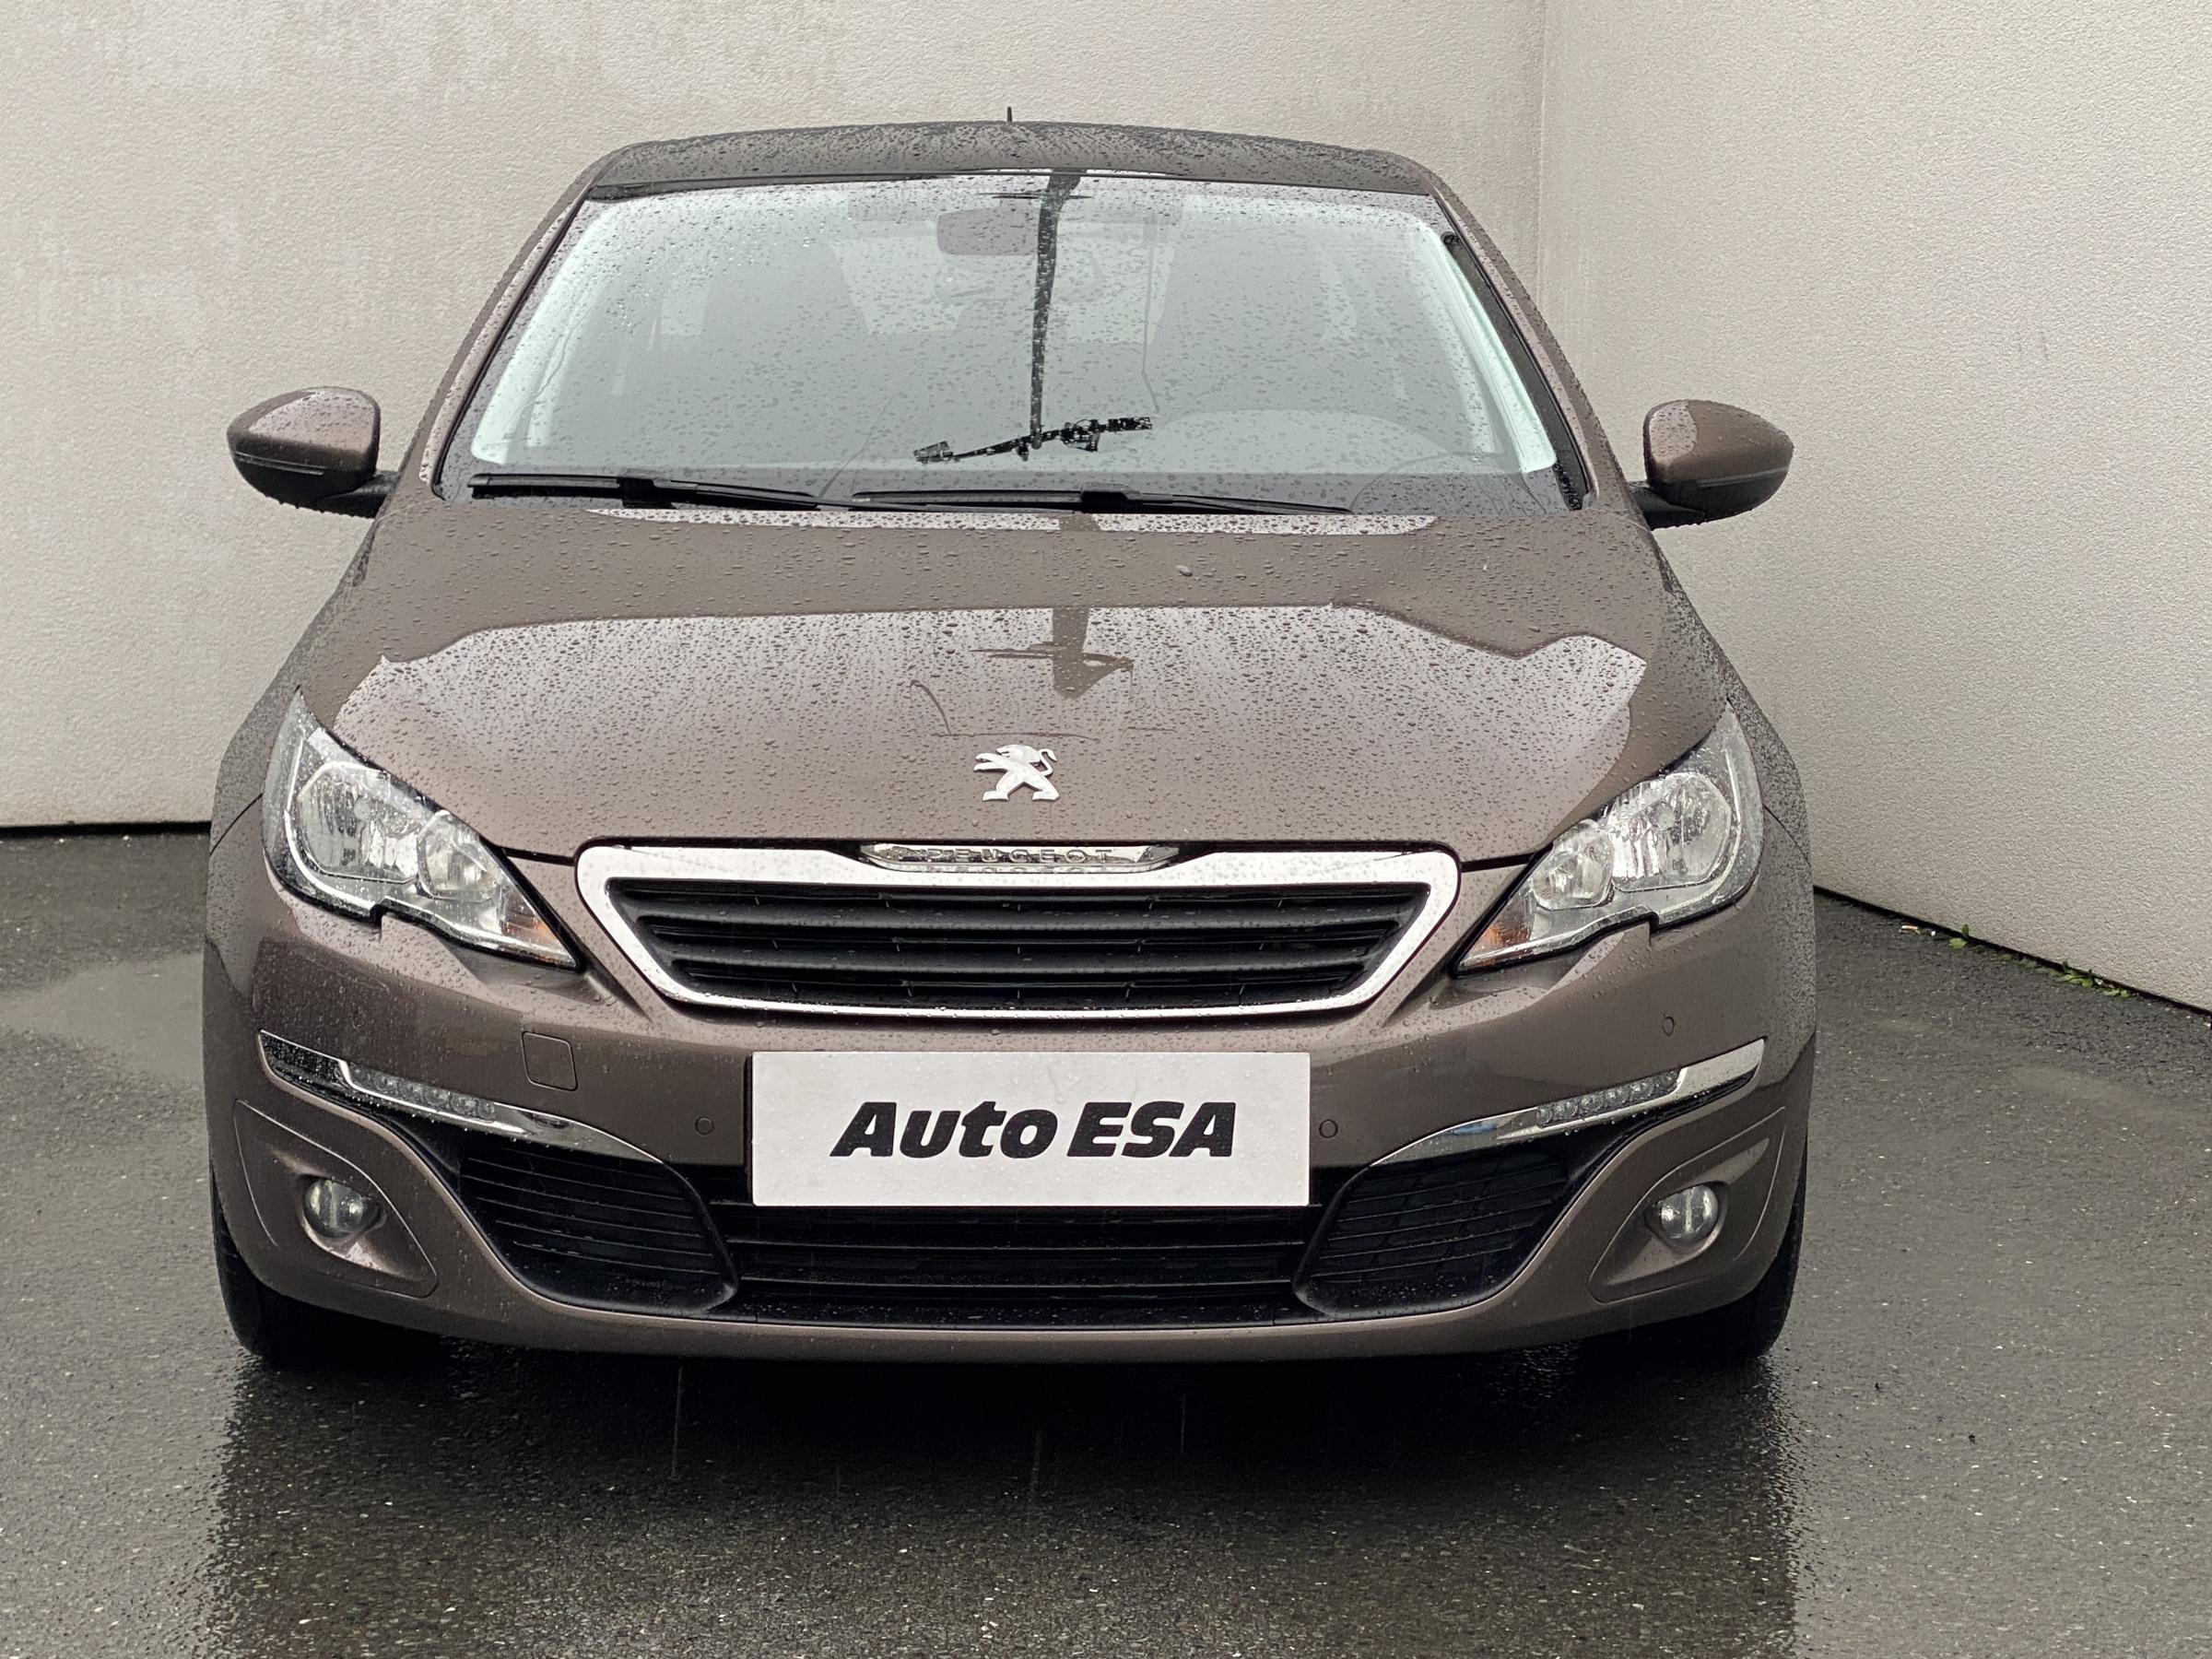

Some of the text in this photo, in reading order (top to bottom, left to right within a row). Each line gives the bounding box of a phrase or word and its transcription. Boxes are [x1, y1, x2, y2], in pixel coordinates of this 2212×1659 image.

[926, 847, 1113, 864] PEUGEOT
[830, 1100, 1237, 1159] Auto ESA
